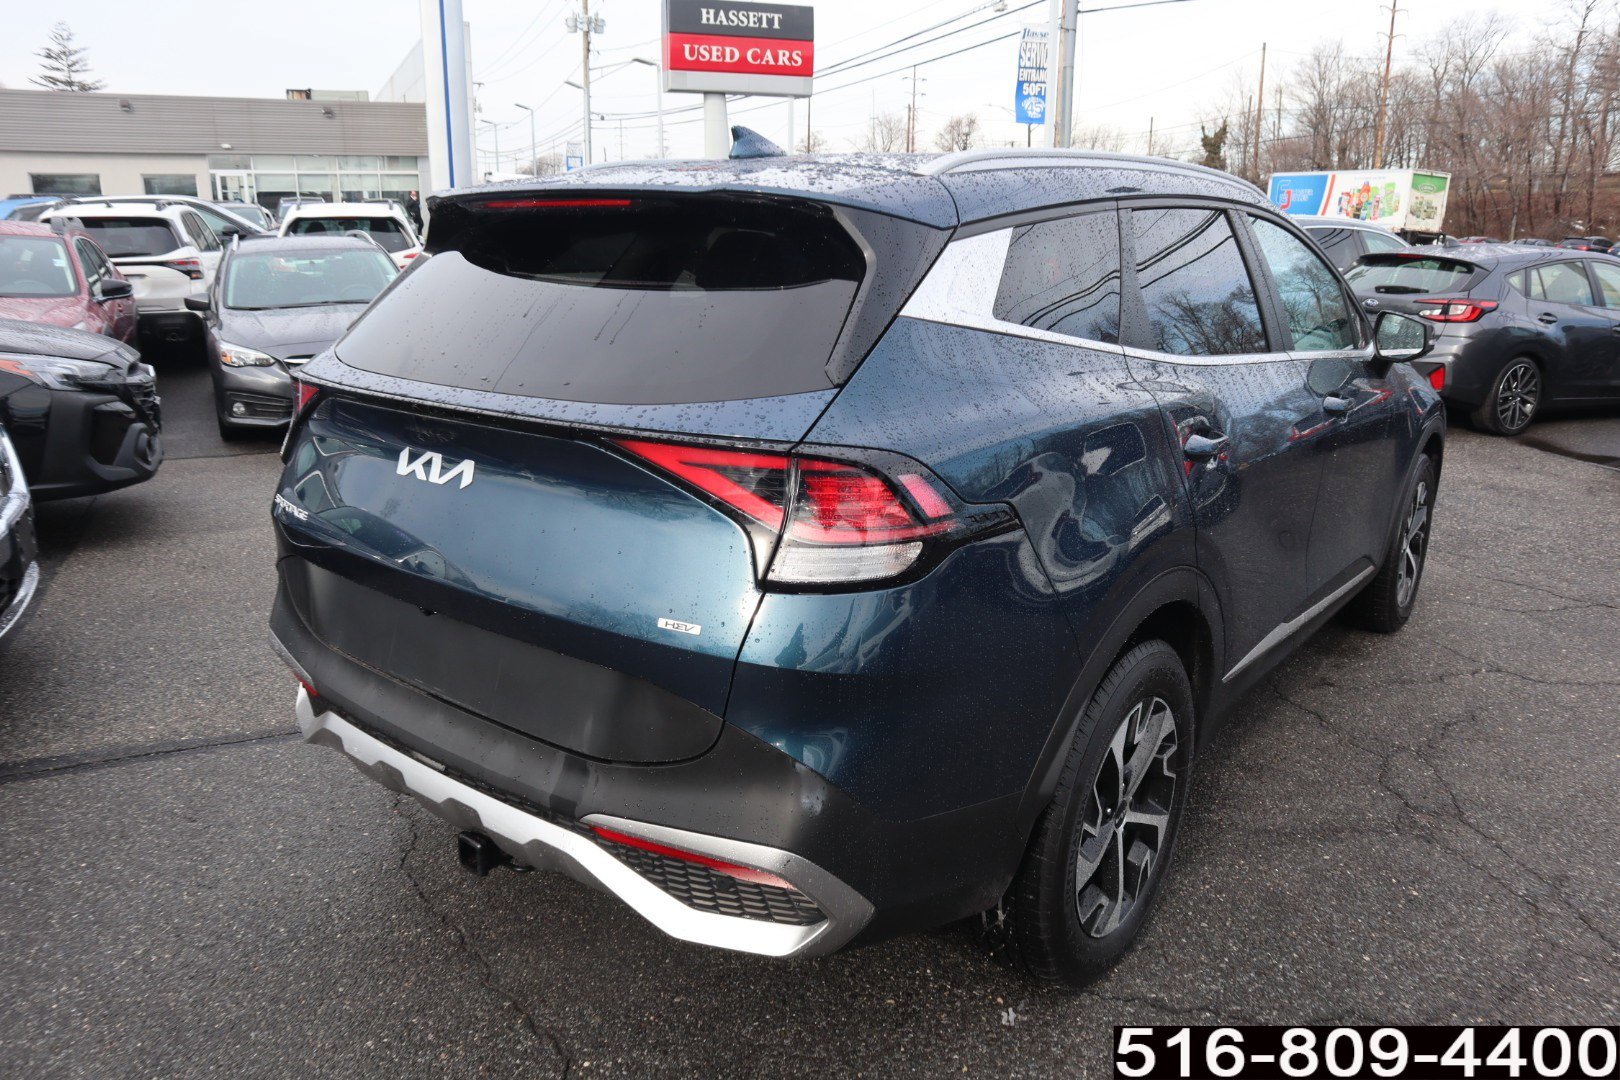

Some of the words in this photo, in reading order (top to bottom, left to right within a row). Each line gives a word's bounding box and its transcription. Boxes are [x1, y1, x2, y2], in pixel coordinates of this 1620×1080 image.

[700, 7, 783, 30] HASSETT
[1022, 27, 1049, 40] Hasse
[683, 43, 740, 63] USED
[746, 47, 803, 67] CARS
[396, 446, 475, 490] KIA
[664, 620, 696, 632] HEV
